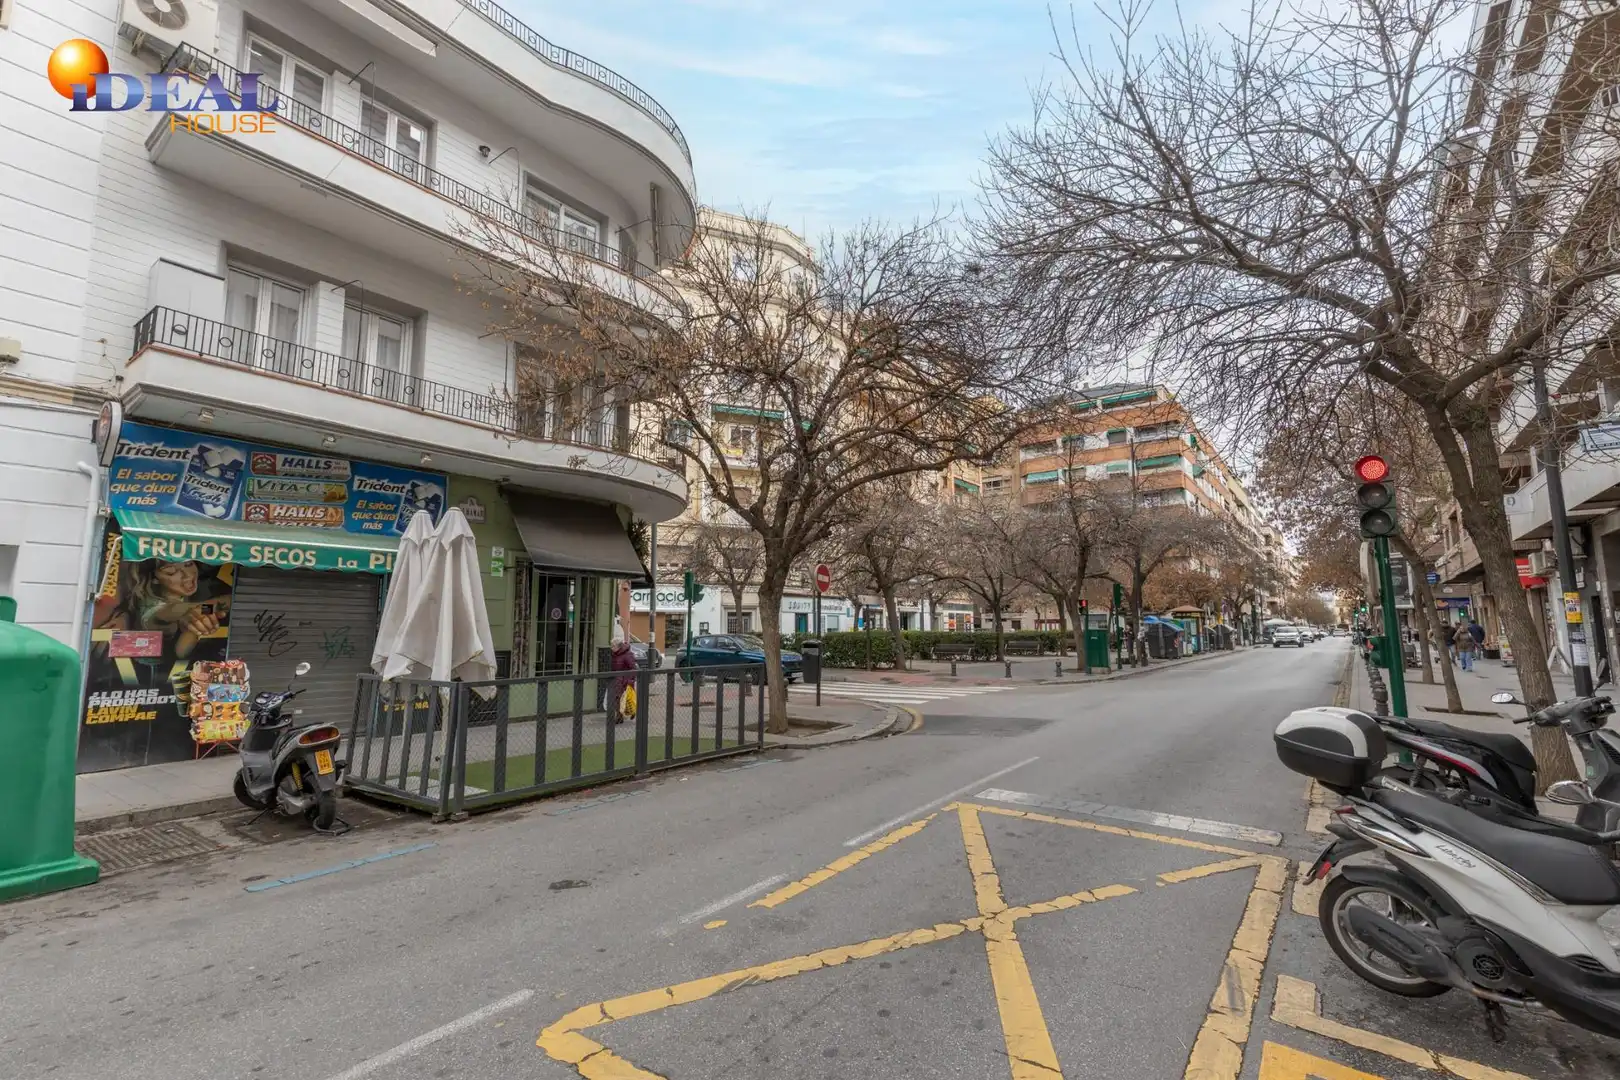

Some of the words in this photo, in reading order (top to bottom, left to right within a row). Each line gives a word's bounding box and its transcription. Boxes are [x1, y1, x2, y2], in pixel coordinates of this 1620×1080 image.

[117, 442, 191, 460] Trident
[281, 457, 332, 470] HALLS
[116, 468, 132, 480] El
[134, 470, 177, 481] sabor
[110, 483, 141, 494] que
[143, 482, 177, 493] dura
[186, 475, 230, 493] Trident
[356, 479, 406, 493] Trident
[127, 494, 158, 505] más
[356, 500, 366, 508] El
[368, 501, 396, 510] sabor
[274, 506, 326, 518] HALLS
[352, 512, 372, 520] que
[373, 511, 398, 520] dura
[362, 521, 383, 530] más
[138, 536, 234, 561] FRUTOS
[248, 545, 317, 567] SECOS
[337, 556, 358, 568] La
[369, 552, 396, 570] PI
[124, 688, 160, 699] HAS
[88, 695, 176, 708] PROBADO?
